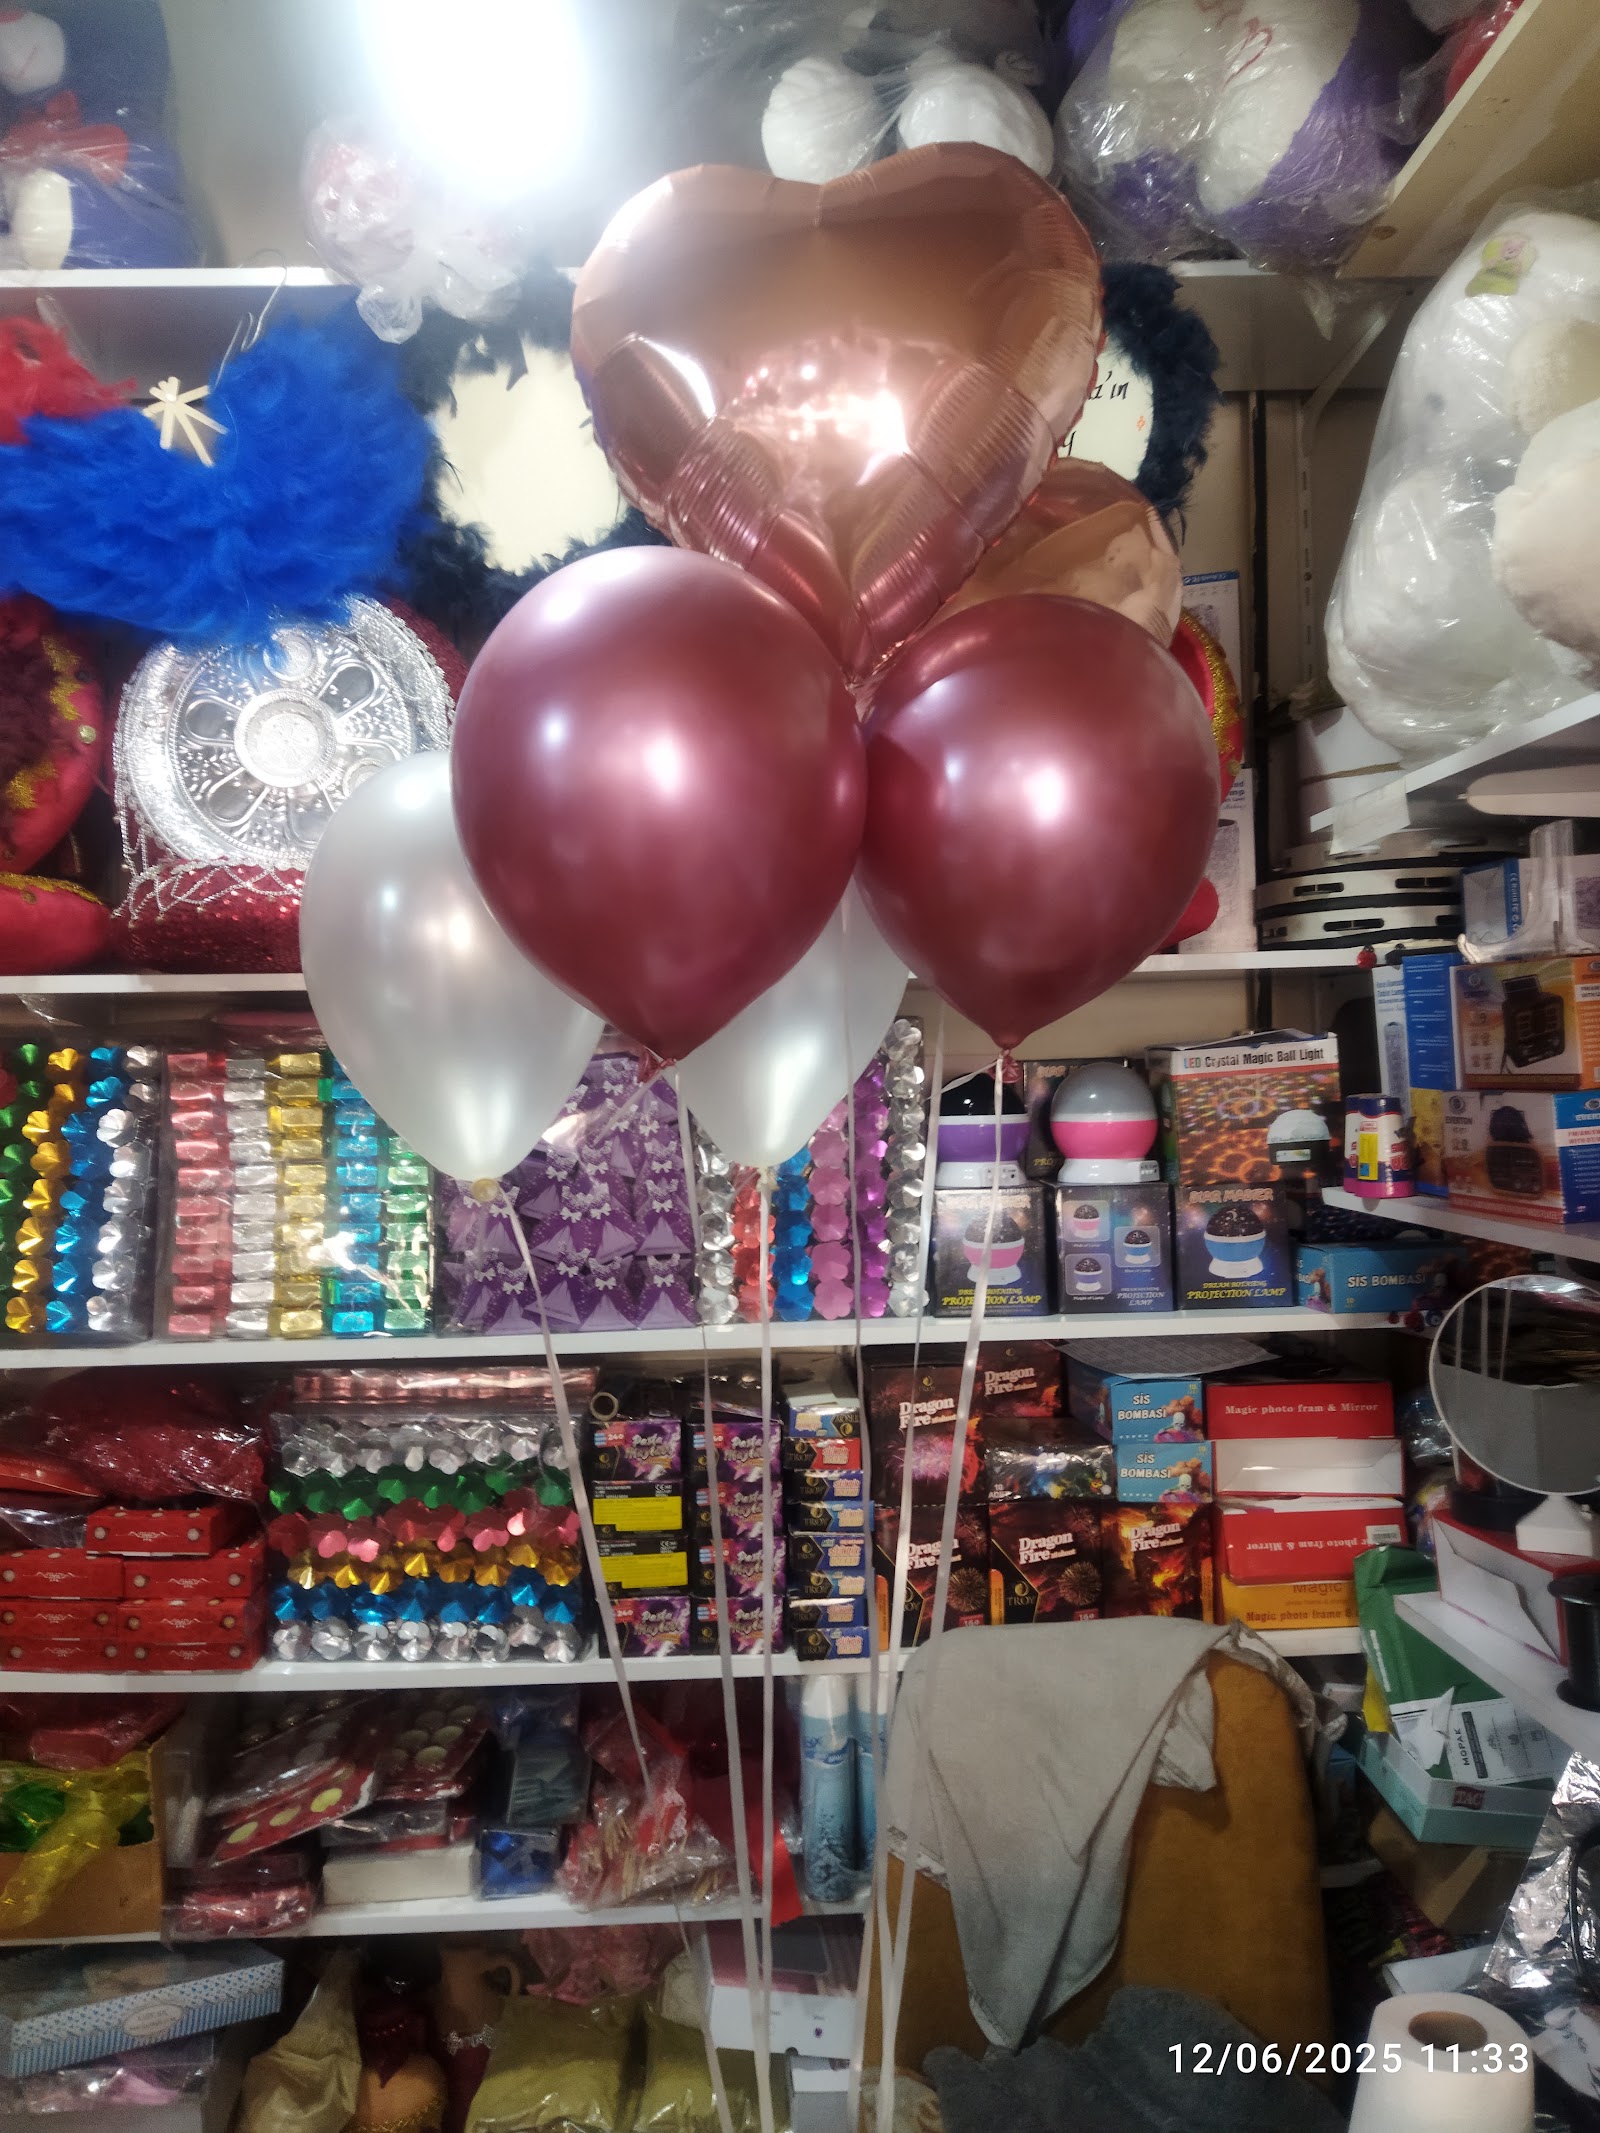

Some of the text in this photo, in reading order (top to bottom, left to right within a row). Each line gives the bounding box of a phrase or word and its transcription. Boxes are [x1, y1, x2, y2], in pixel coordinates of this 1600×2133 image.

[1183, 1048, 1324, 1069] LED Crystal Magic Ball Light
[1008, 1295, 1043, 1305] LAMP
[1116, 1291, 1166, 1300] PROJECTION
[1186, 1287, 1287, 1300] PROJECTION LAMP
[1128, 1299, 1154, 1307] LAMP
[984, 1367, 1035, 1383] Dragon
[984, 1381, 1014, 1397] Fire
[899, 1398, 955, 1416] Dragon
[1225, 1402, 1379, 1416] Magic photo fram & Mirror
[1117, 1408, 1167, 1421] BOMBASI
[1120, 1468, 1171, 1479] BOMBASI
[1130, 1523, 1182, 1540] Dragon
[1019, 1533, 1074, 1551] Dragon
[1130, 1537, 1160, 1552] Fire
[1246, 1542, 1283, 1551] Mirror
[1297, 1540, 1324, 1549] fram
[1326, 1537, 1358, 1548] photo
[1019, 1548, 1051, 1565] Fire
[1007, 1596, 1036, 1606] TROY
[1246, 1611, 1277, 1622] Magic
[1280, 1610, 1309, 1621] photo
[1453, 1727, 1470, 1767] MOPAK
